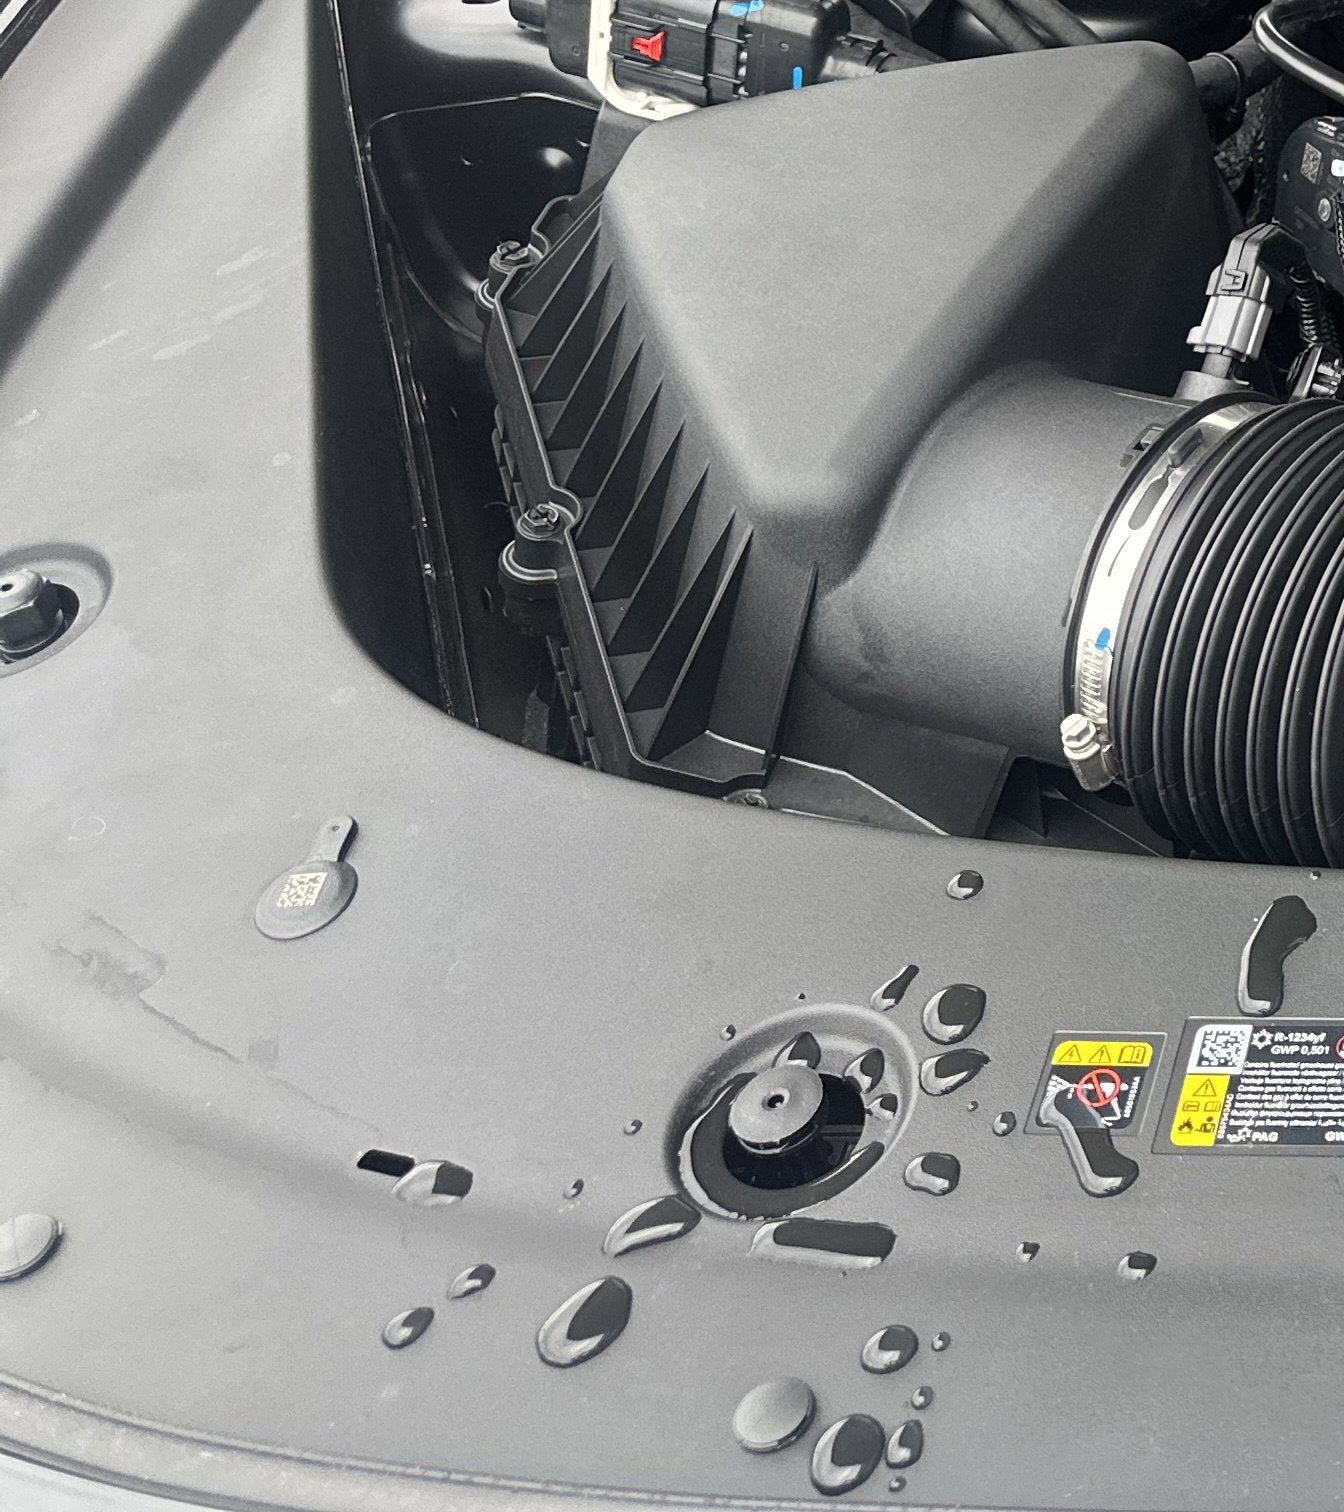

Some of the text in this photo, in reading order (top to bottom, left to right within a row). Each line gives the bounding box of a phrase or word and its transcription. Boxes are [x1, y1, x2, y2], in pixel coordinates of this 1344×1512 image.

[1274, 1032, 1327, 1045] R-1234yf
[1270, 1045, 1300, 1055] GWP
[1251, 1131, 1279, 1142] PAG
